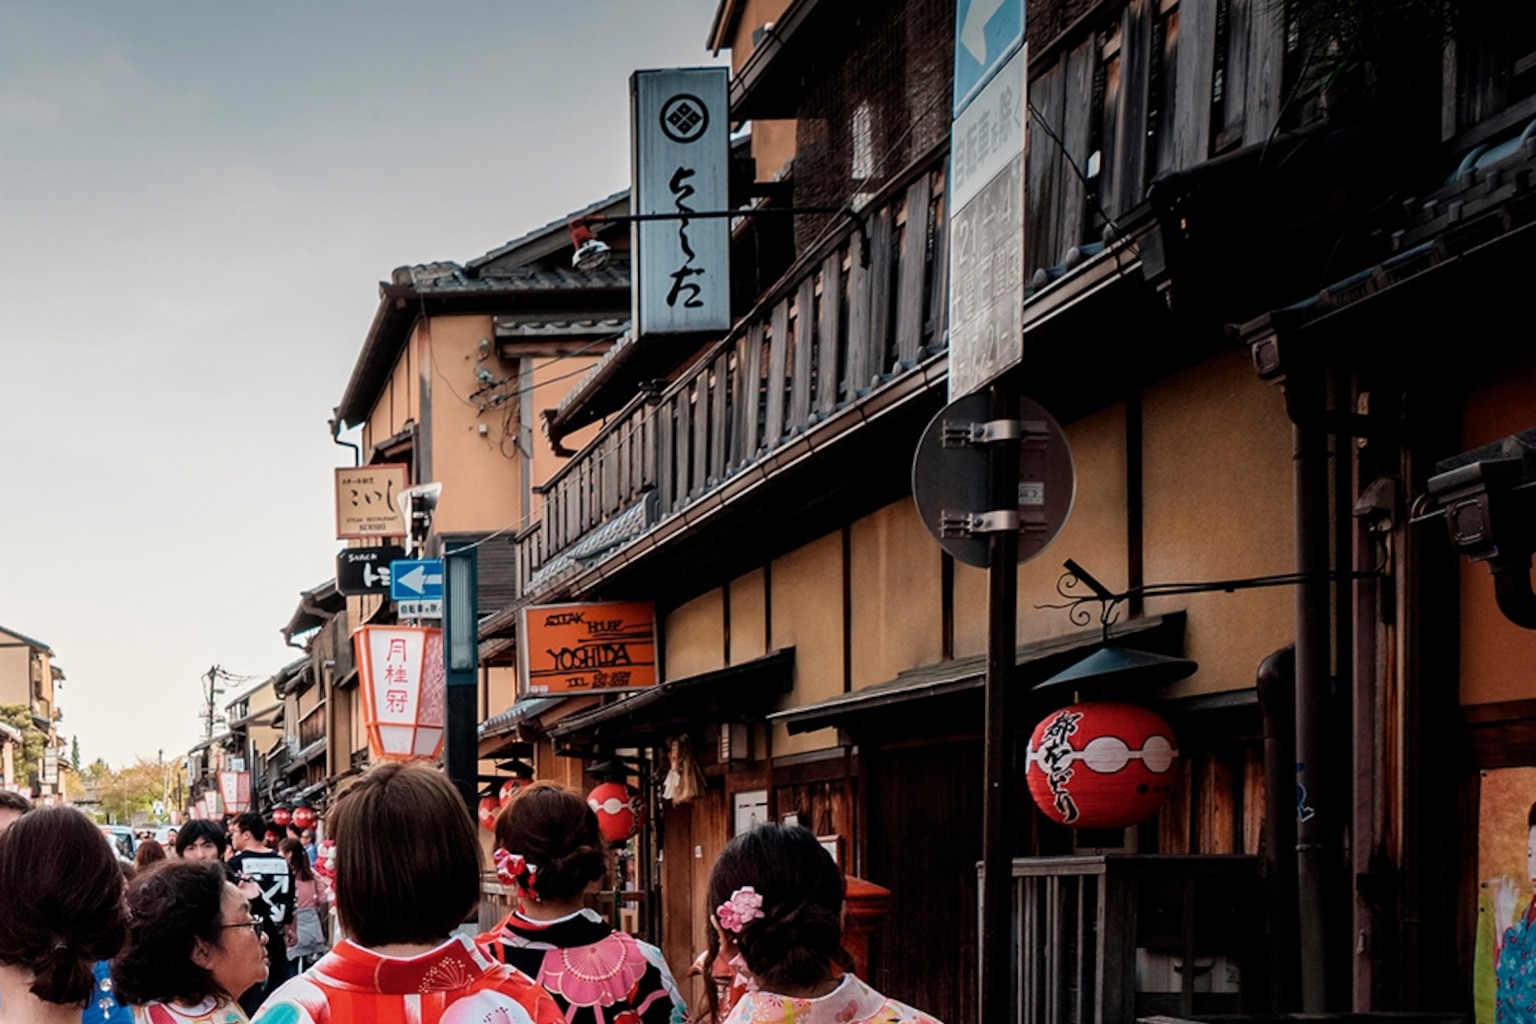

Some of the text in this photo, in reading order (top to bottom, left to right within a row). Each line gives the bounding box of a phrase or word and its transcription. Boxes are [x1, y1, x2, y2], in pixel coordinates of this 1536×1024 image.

[384, 639, 408, 713] 月桂冠
[546, 643, 632, 671] YOSHIDA
